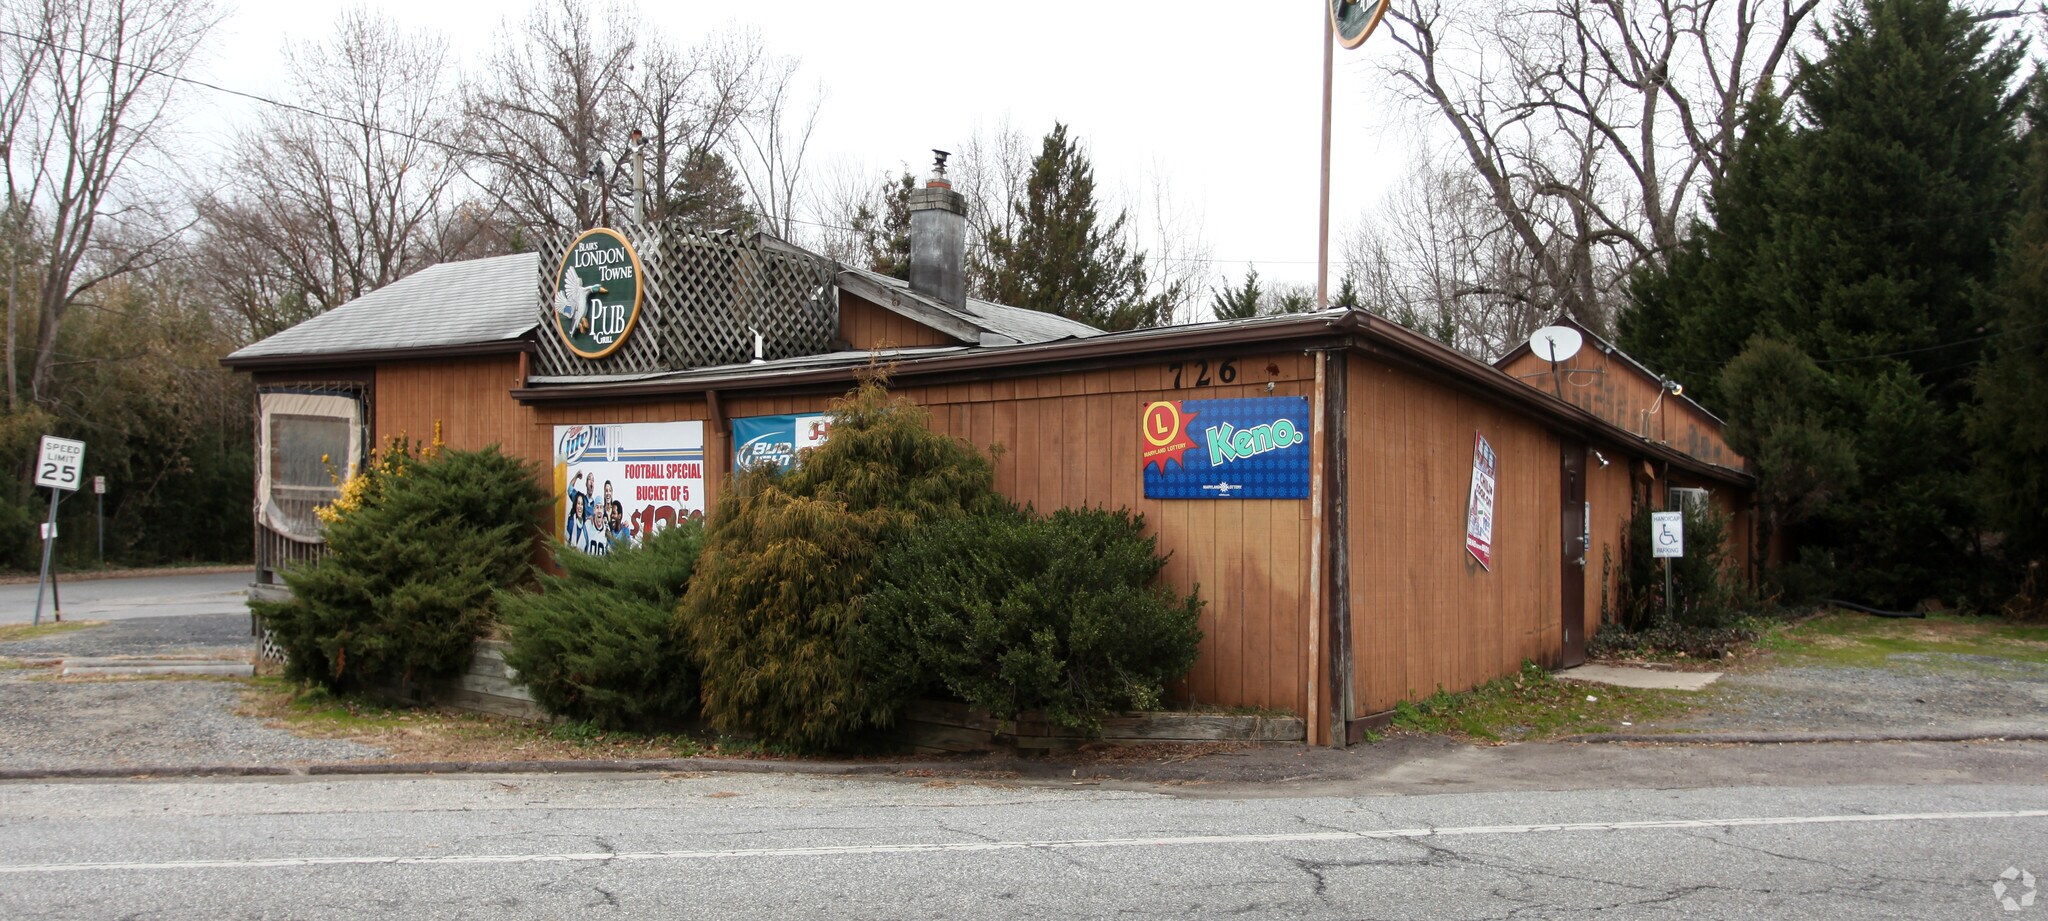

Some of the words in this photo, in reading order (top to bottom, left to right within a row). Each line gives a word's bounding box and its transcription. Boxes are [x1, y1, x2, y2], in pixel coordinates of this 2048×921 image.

[574, 247, 625, 268] LONDON
[598, 265, 633, 282] TOWNE
[589, 298, 625, 336] PUB
[1168, 356, 1238, 390] 726
[594, 427, 606, 446] FAN
[45, 443, 80, 454] SPEED
[1143, 447, 1166, 457] MARYLAND
[48, 454, 75, 463] LIMIT
[42, 463, 75, 482] 25
[625, 463, 665, 479] FOOTBALL
[666, 463, 701, 479] SPECIAL
[636, 486, 669, 501] BUCKET
[670, 486, 681, 501] OF
[682, 485, 689, 501] 5
